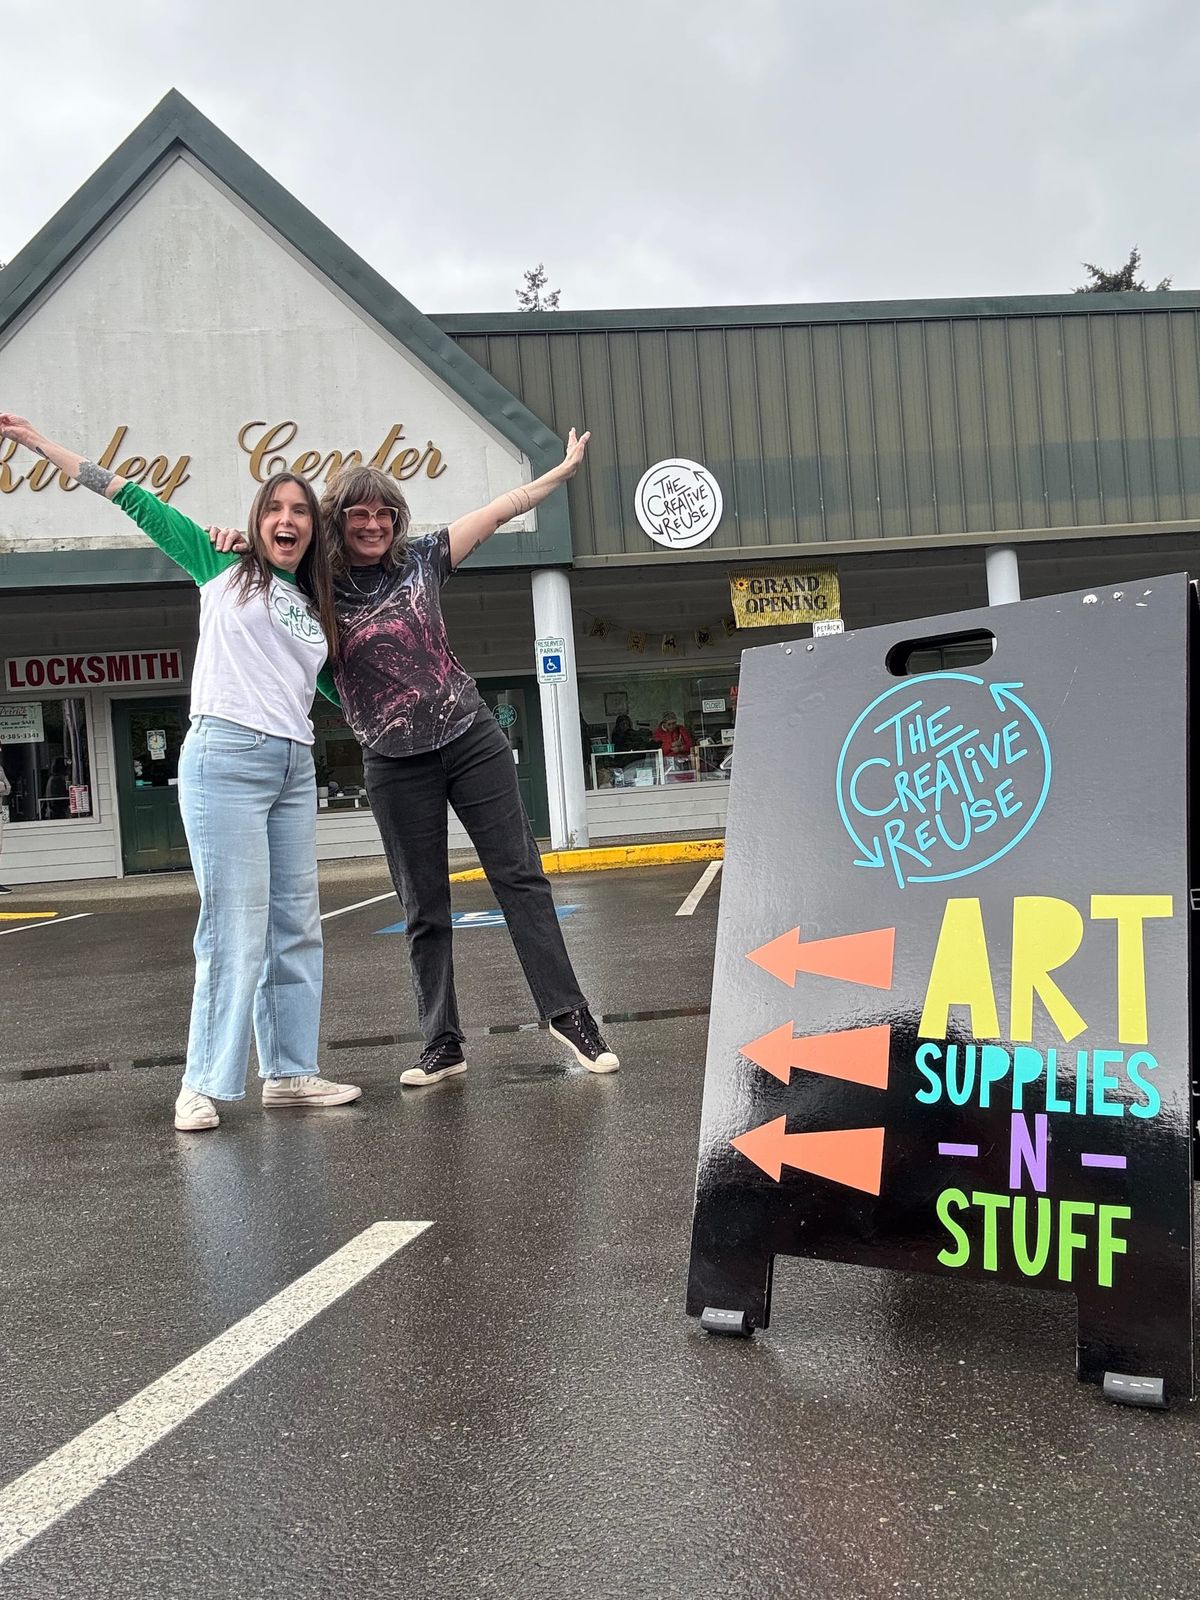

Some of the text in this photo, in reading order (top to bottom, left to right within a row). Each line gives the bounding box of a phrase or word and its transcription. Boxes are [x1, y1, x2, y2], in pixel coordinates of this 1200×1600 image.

[238, 420, 448, 483] Center
[653, 474, 686, 499] THE
[745, 594, 828, 614] OPENING
[750, 576, 820, 595] GRAND
[816, 624, 841, 632] PETRICK
[8, 652, 180, 688] LOCKSMITH
[872, 700, 964, 767] THE
[917, 894, 1174, 1045] ART
[914, 1042, 1161, 1119] SUPPLIES
[1009, 1112, 1047, 1192] N
[936, 1187, 1132, 1288] STUFF
